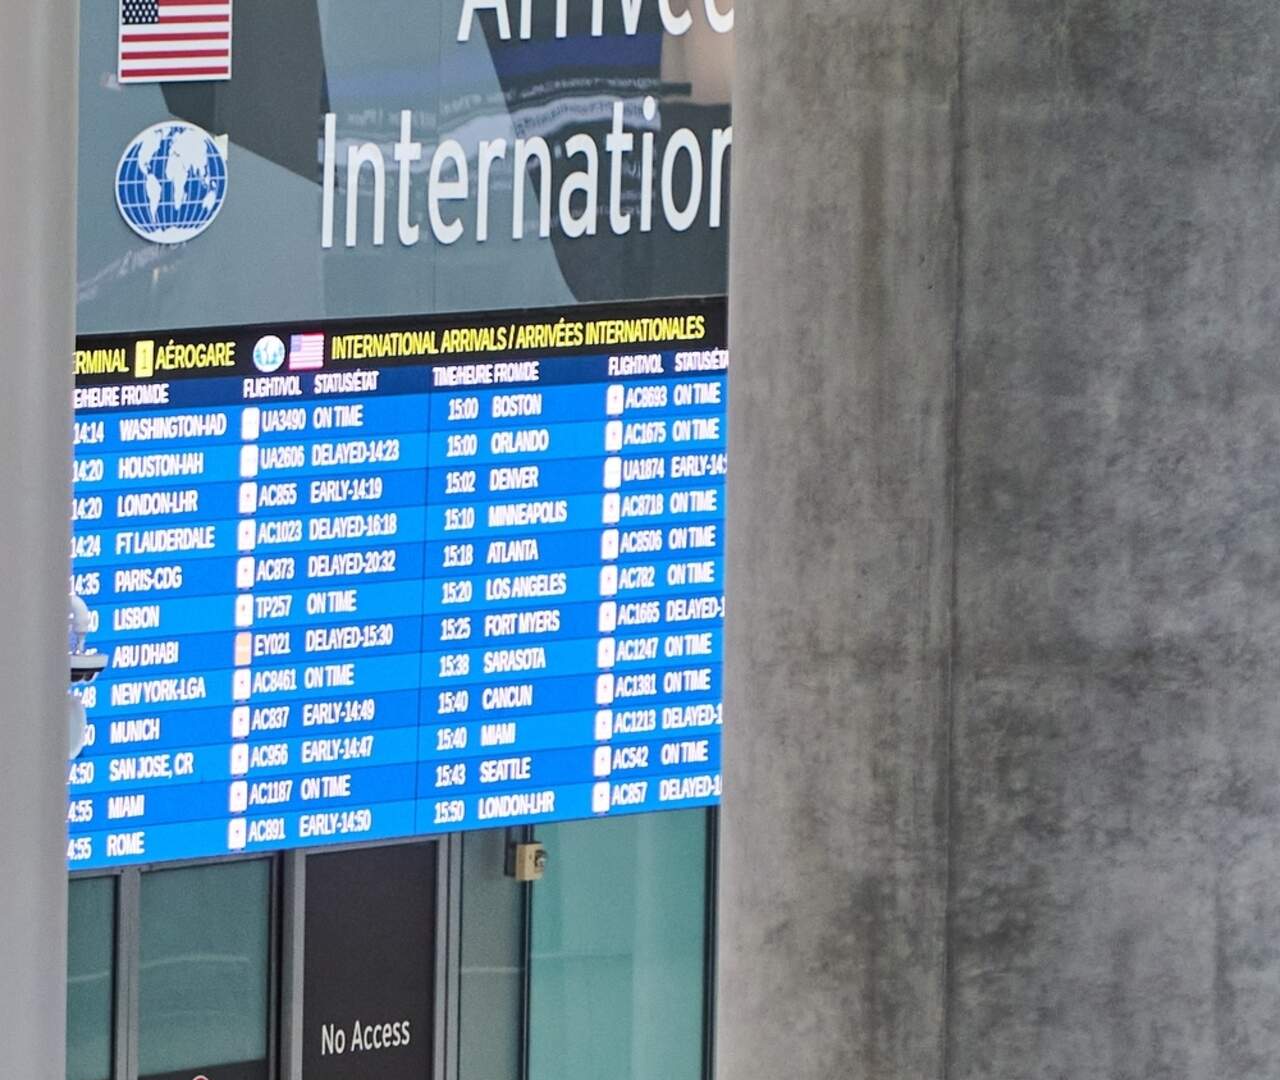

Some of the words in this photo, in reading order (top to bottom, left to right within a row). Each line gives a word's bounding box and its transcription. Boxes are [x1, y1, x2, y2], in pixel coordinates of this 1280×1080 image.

[332, 331, 439, 360] INTERNATIONAL
[440, 325, 507, 353] ARRIVALS
[516, 318, 583, 348] ARRIVÉES
[586, 316, 705, 342] INTERNATIONALES
[155, 339, 236, 369] AÉROGARE
[448, 397, 479, 421] 15:00
[492, 393, 542, 418] BOSTON
[310, 477, 383, 504] EARLY-14:19
[489, 466, 539, 491] DENVER
[487, 539, 539, 563] ATLANTA
[113, 605, 160, 631] LISBON
[482, 685, 533, 710] CANCUN
[110, 718, 160, 744] MUNICH
[479, 756, 531, 783] SEATTLE
[106, 831, 145, 857] ROME
[321, 1025, 344, 1056] No
[351, 1019, 410, 1050] Access
